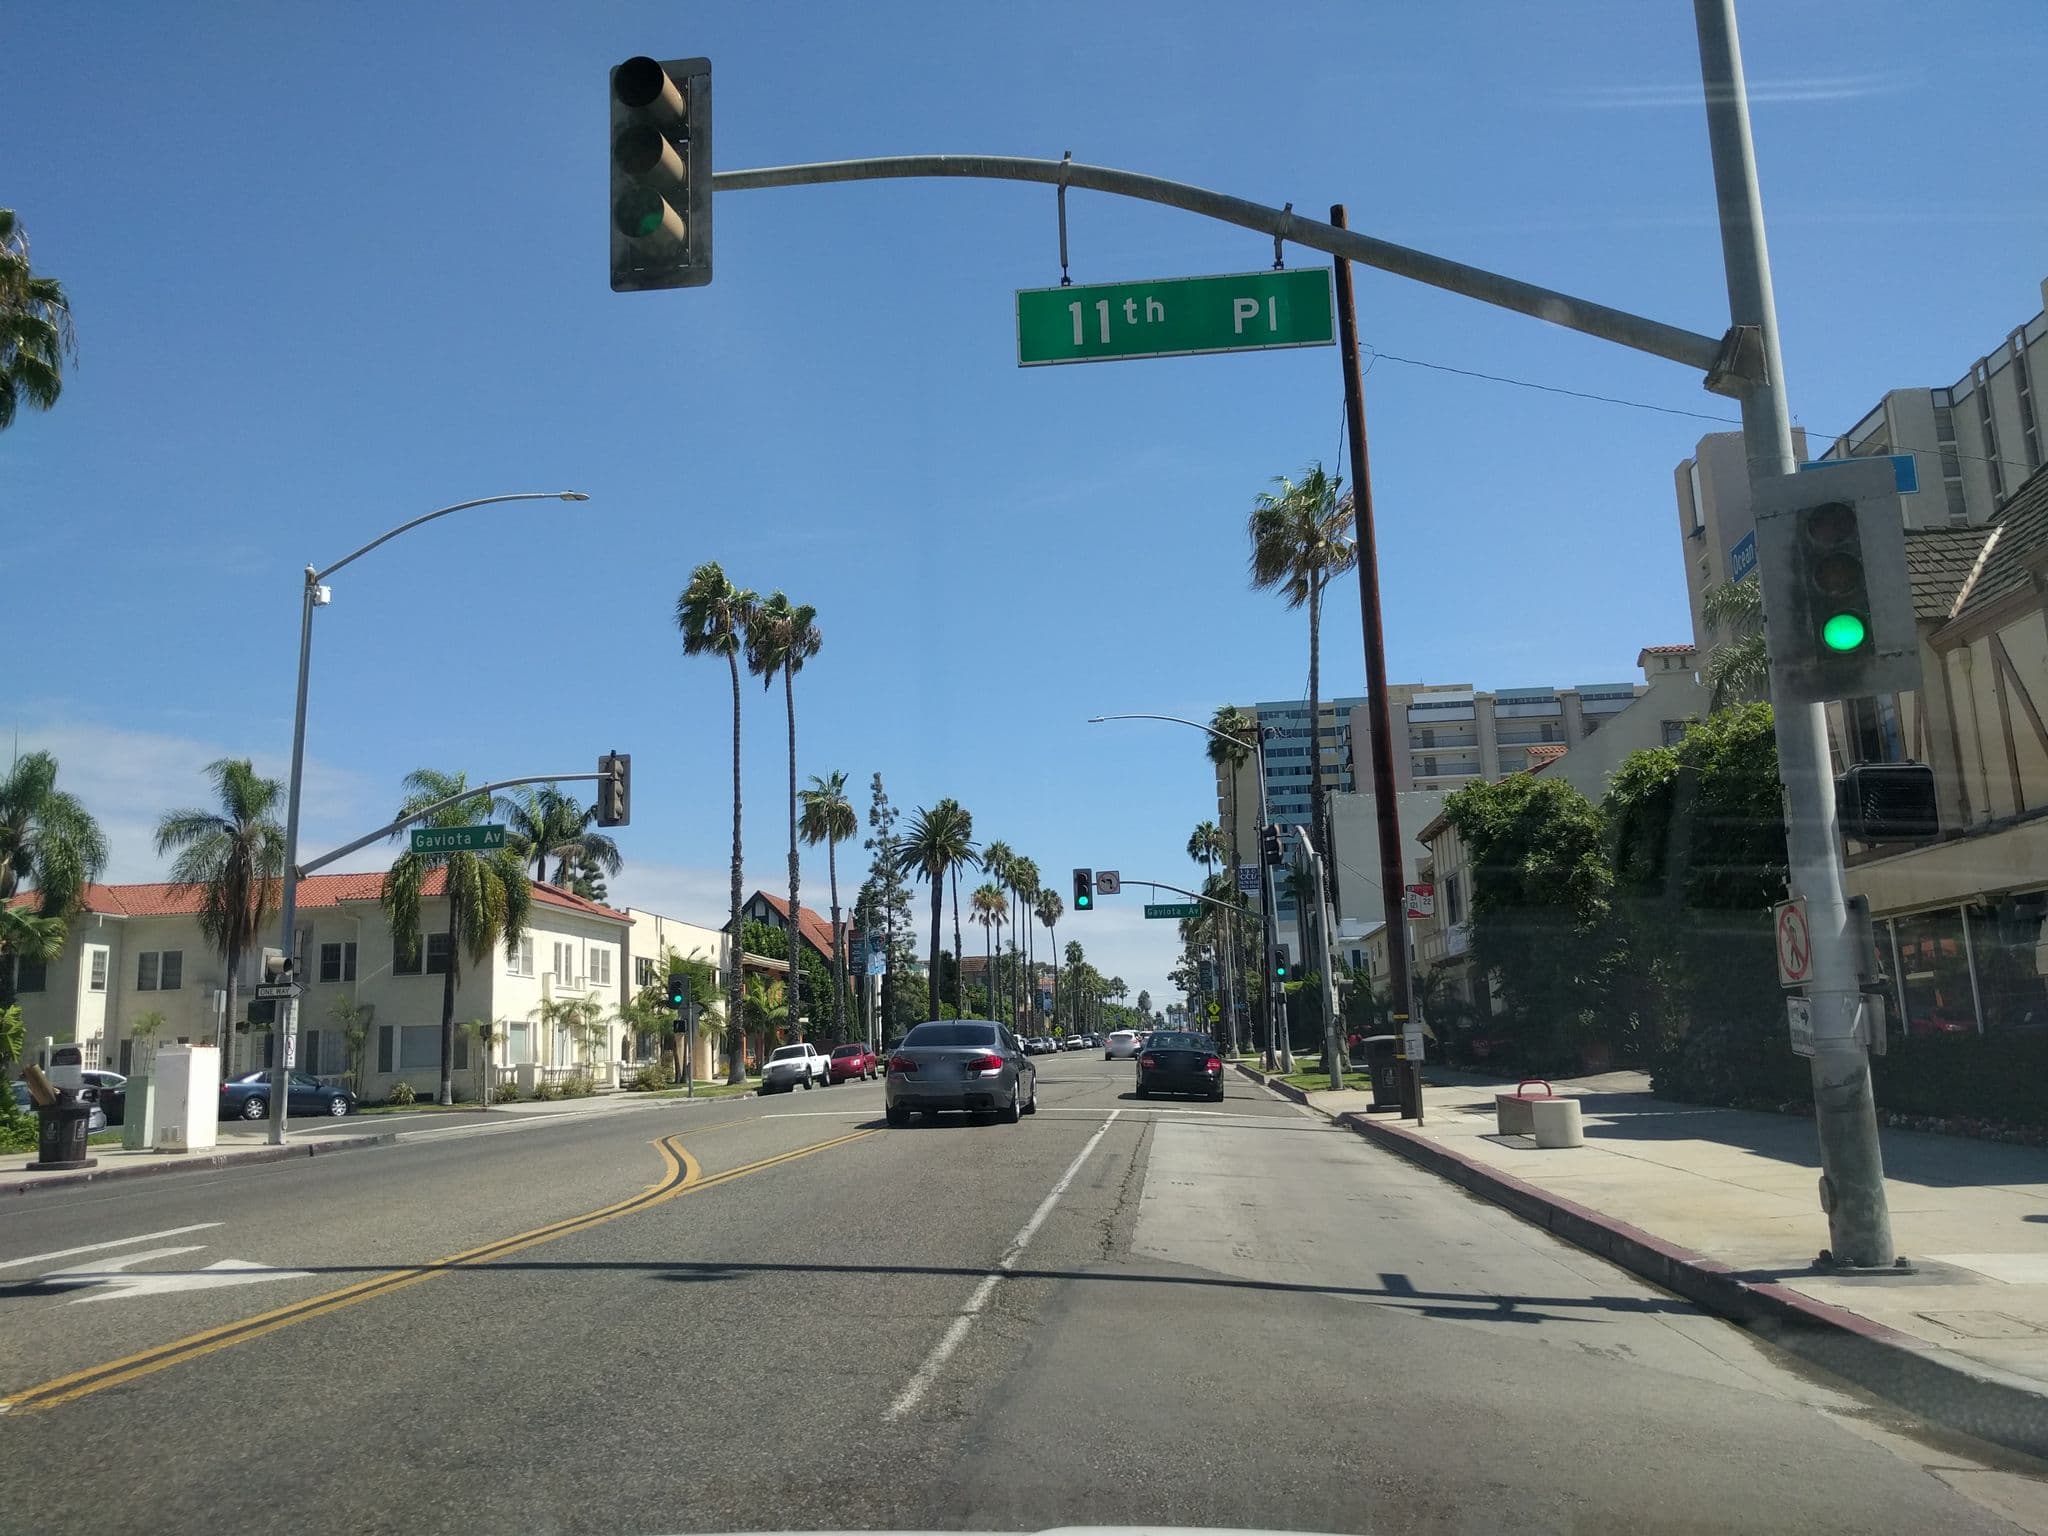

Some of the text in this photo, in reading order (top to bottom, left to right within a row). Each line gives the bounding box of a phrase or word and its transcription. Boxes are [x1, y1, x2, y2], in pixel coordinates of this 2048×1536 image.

[1067, 295, 1278, 346] 11th Pl
[1733, 543, 1754, 575] Ocean
[415, 830, 501, 848] Gaviota Av
[1423, 897, 1432, 905] 22
[1147, 907, 1182, 916] Gaviota
[260, 987, 290, 996] ONE WAY
